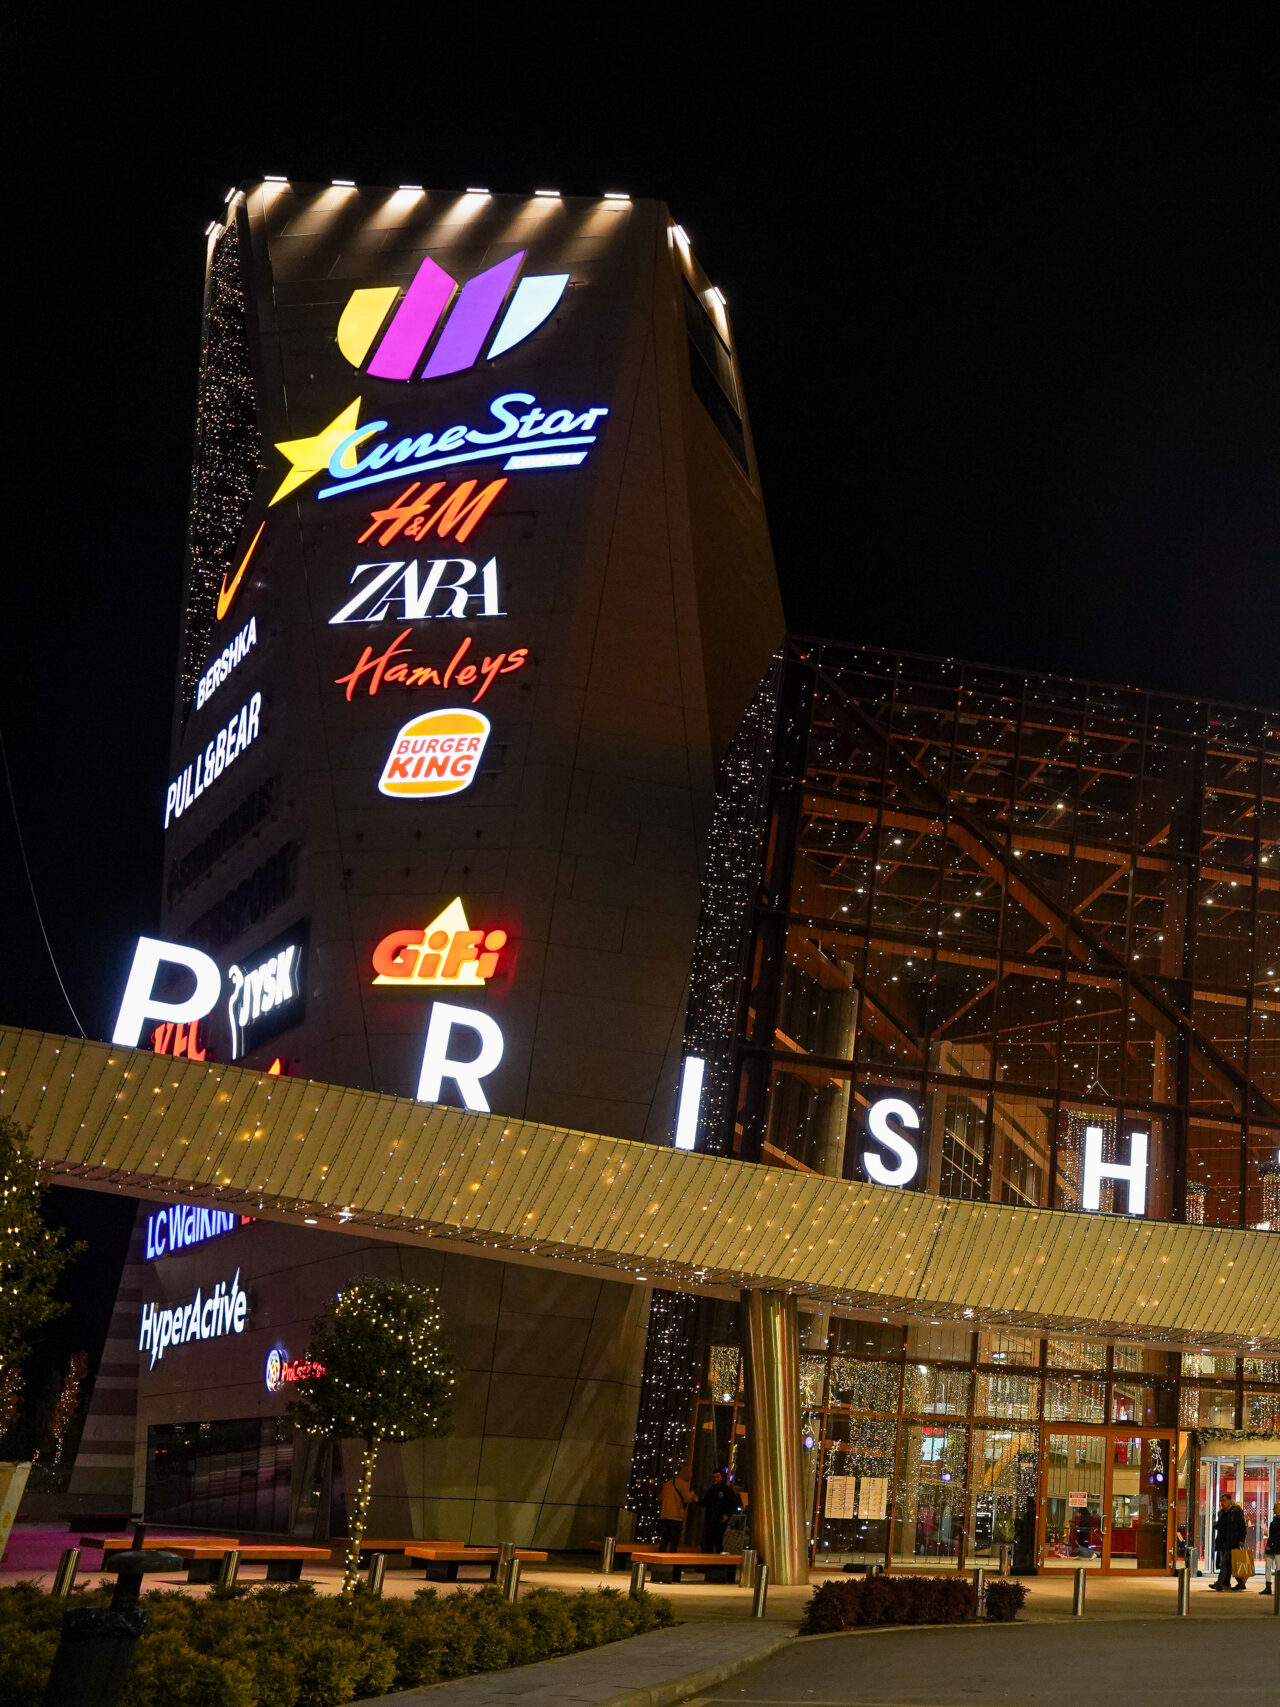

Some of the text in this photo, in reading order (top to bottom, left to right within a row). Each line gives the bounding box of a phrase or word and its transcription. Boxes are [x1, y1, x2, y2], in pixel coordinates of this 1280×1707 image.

[329, 393, 608, 479] CineStar
[357, 478, 508, 546] H&M
[328, 556, 508, 624] ZARA
[197, 616, 257, 710] BERSHKA
[334, 628, 528, 703] Hamleys
[164, 692, 261, 829] PULL&BEAR
[387, 755, 474, 779] KING
[396, 737, 481, 754] BURGER
[239, 945, 295, 1027] JYSK
[147, 1210, 167, 1259] LC
[138, 1267, 247, 1371] HyperActive
